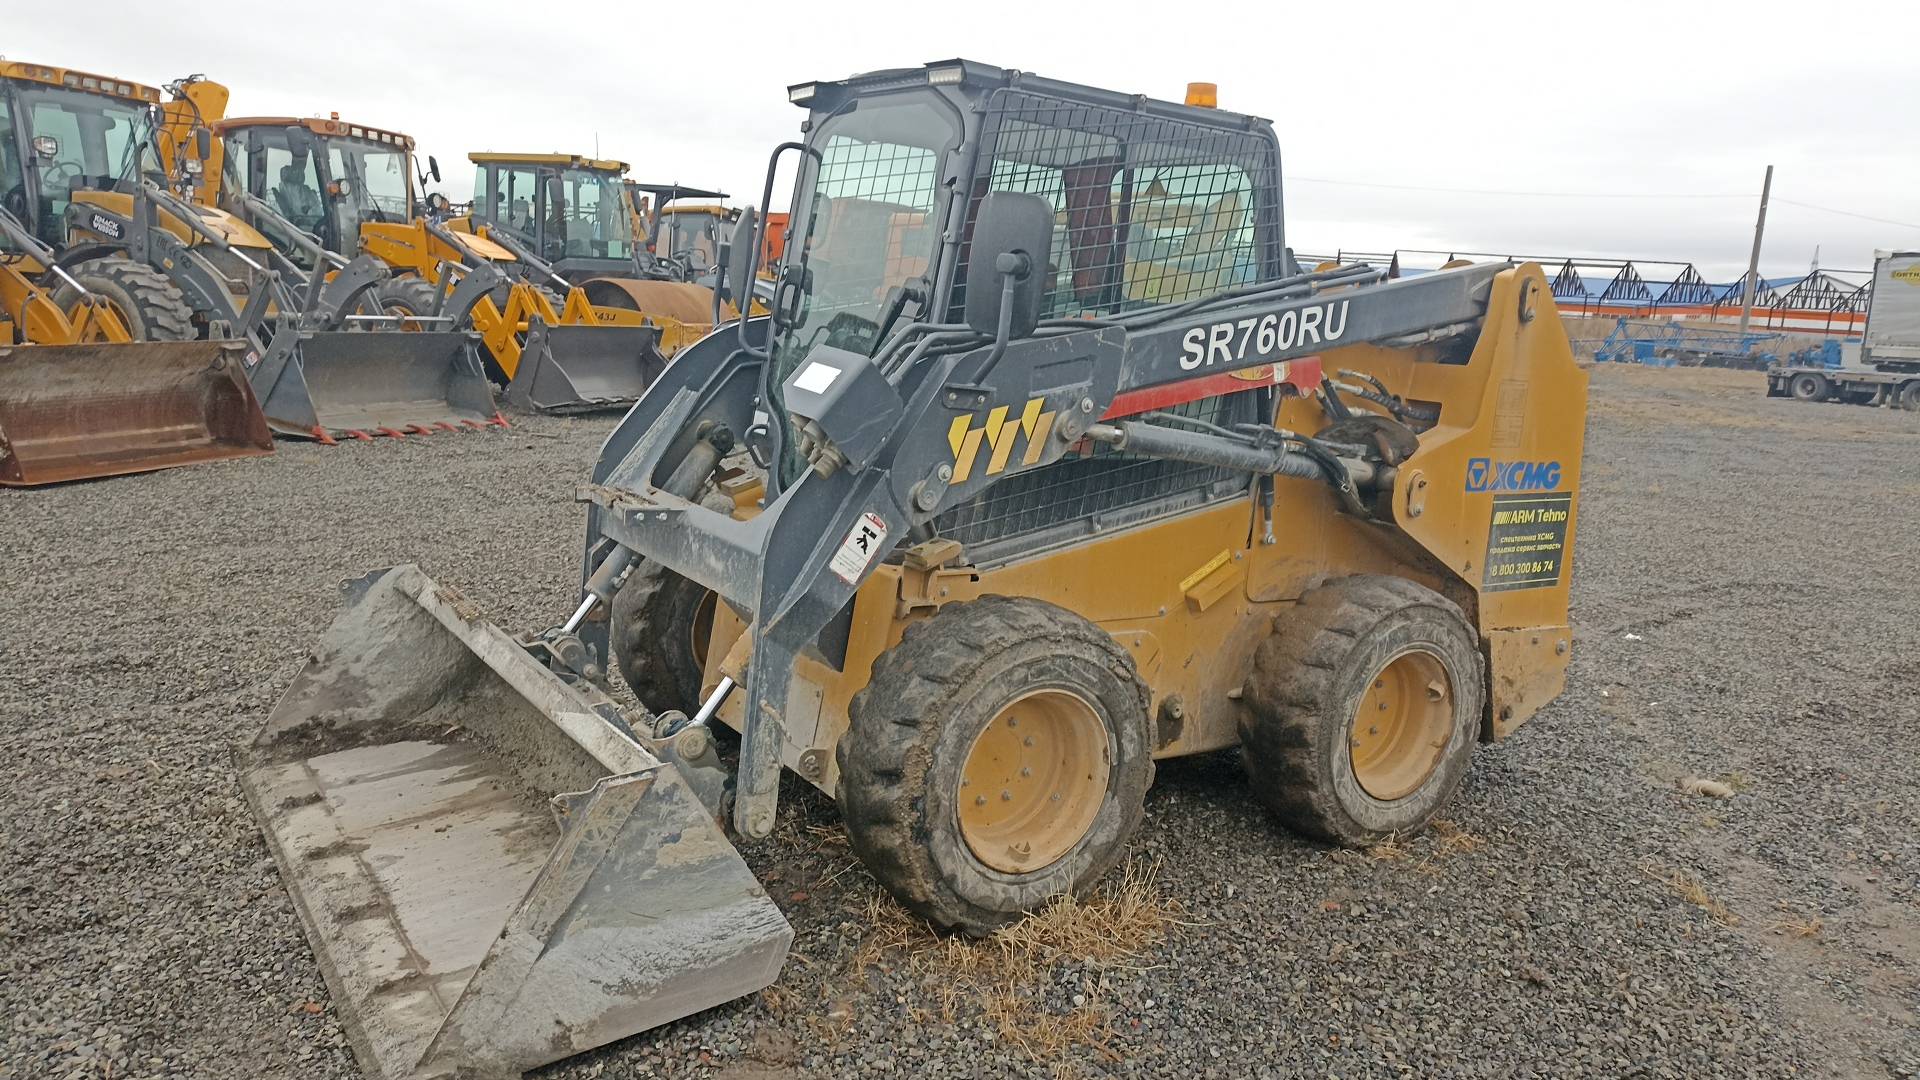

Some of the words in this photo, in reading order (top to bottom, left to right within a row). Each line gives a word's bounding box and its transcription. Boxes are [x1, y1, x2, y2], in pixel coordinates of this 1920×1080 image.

[1179, 299, 1350, 371] SR760RU
[1488, 460, 1561, 490] XCMG
[1510, 510, 1536, 524] ARM
[1538, 508, 1567, 522] Tehno
[1492, 565, 1498, 577] 8
[1499, 563, 1514, 576] 800
[1516, 562, 1531, 574] 300
[1532, 561, 1542, 573] 86
[1543, 560, 1554, 571] 74
